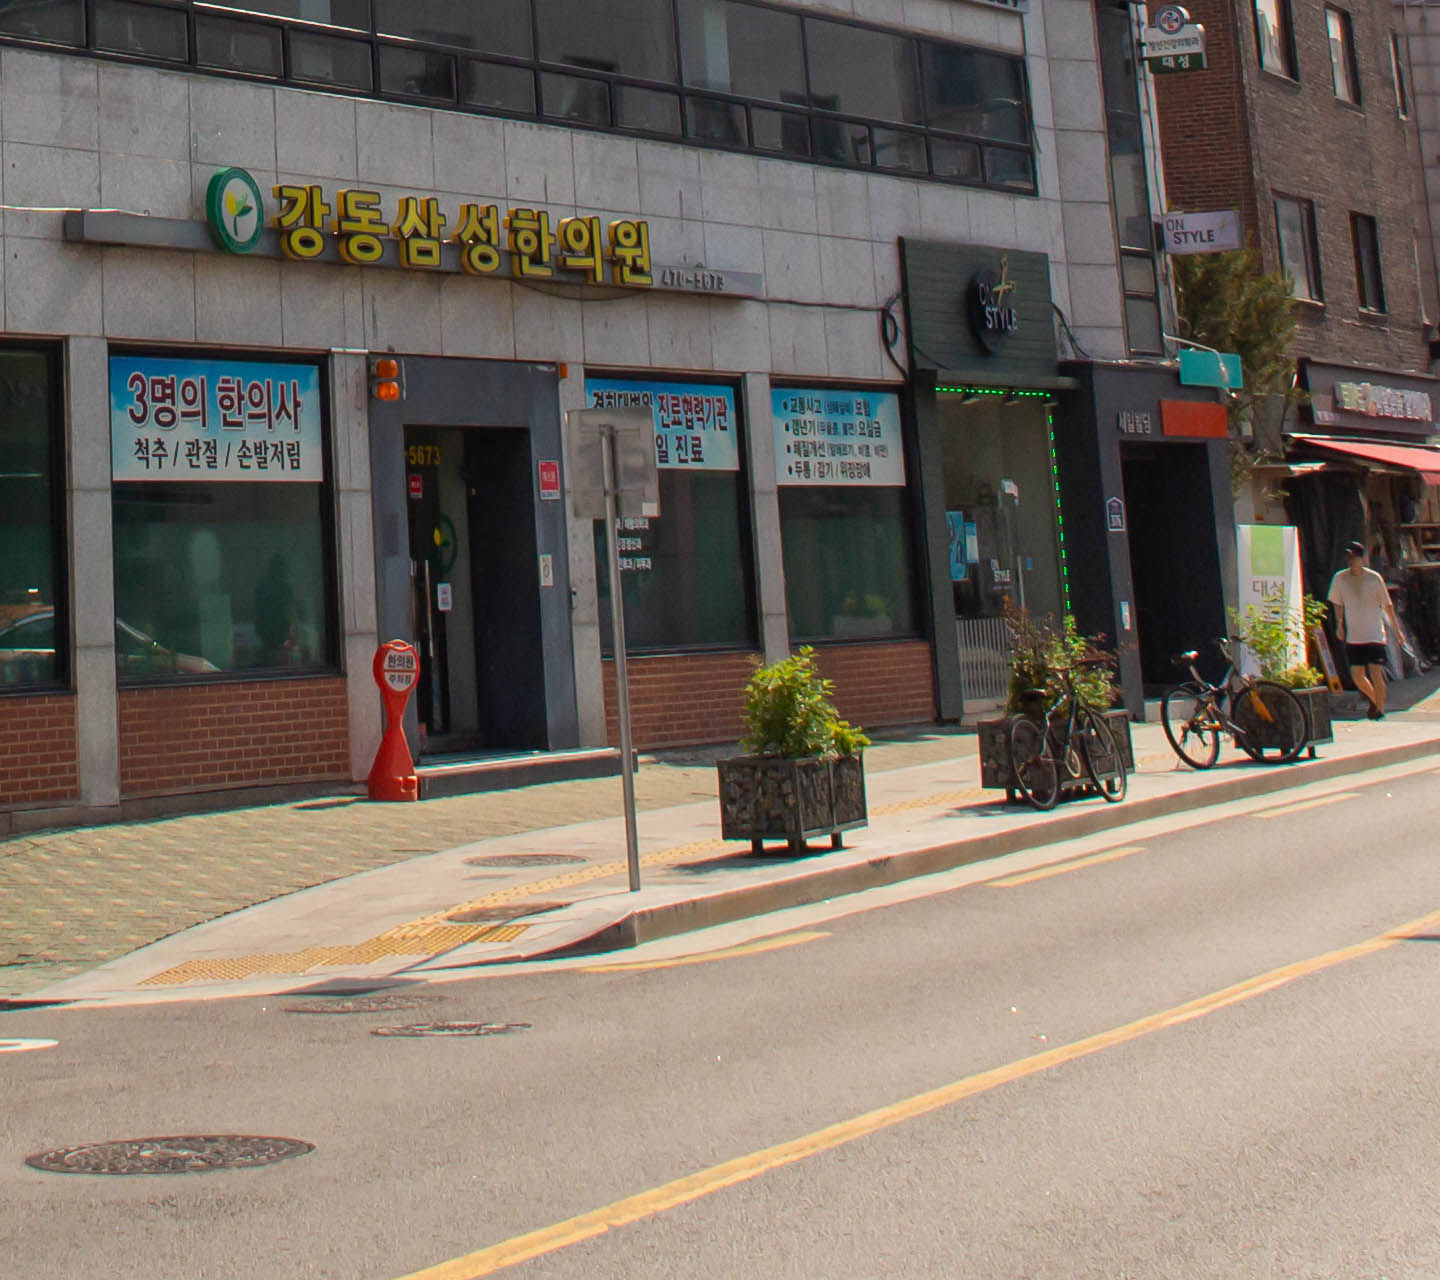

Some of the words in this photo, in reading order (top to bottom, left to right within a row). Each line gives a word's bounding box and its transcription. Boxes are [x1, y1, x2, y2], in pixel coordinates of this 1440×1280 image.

[272, 184, 653, 285] 강동삼성한의원
[1166, 219, 1185, 232] ON
[1173, 229, 1215, 245] STYLE
[985, 306, 1018, 331] STYLE
[128, 372, 208, 429] 3명의
[217, 377, 302, 431] 한의사
[658, 394, 728, 431] 진료협력기관
[134, 438, 169, 470] 척추
[185, 439, 218, 470] 관절
[236, 439, 302, 470] 손발저림
[675, 435, 705, 464] 진료
